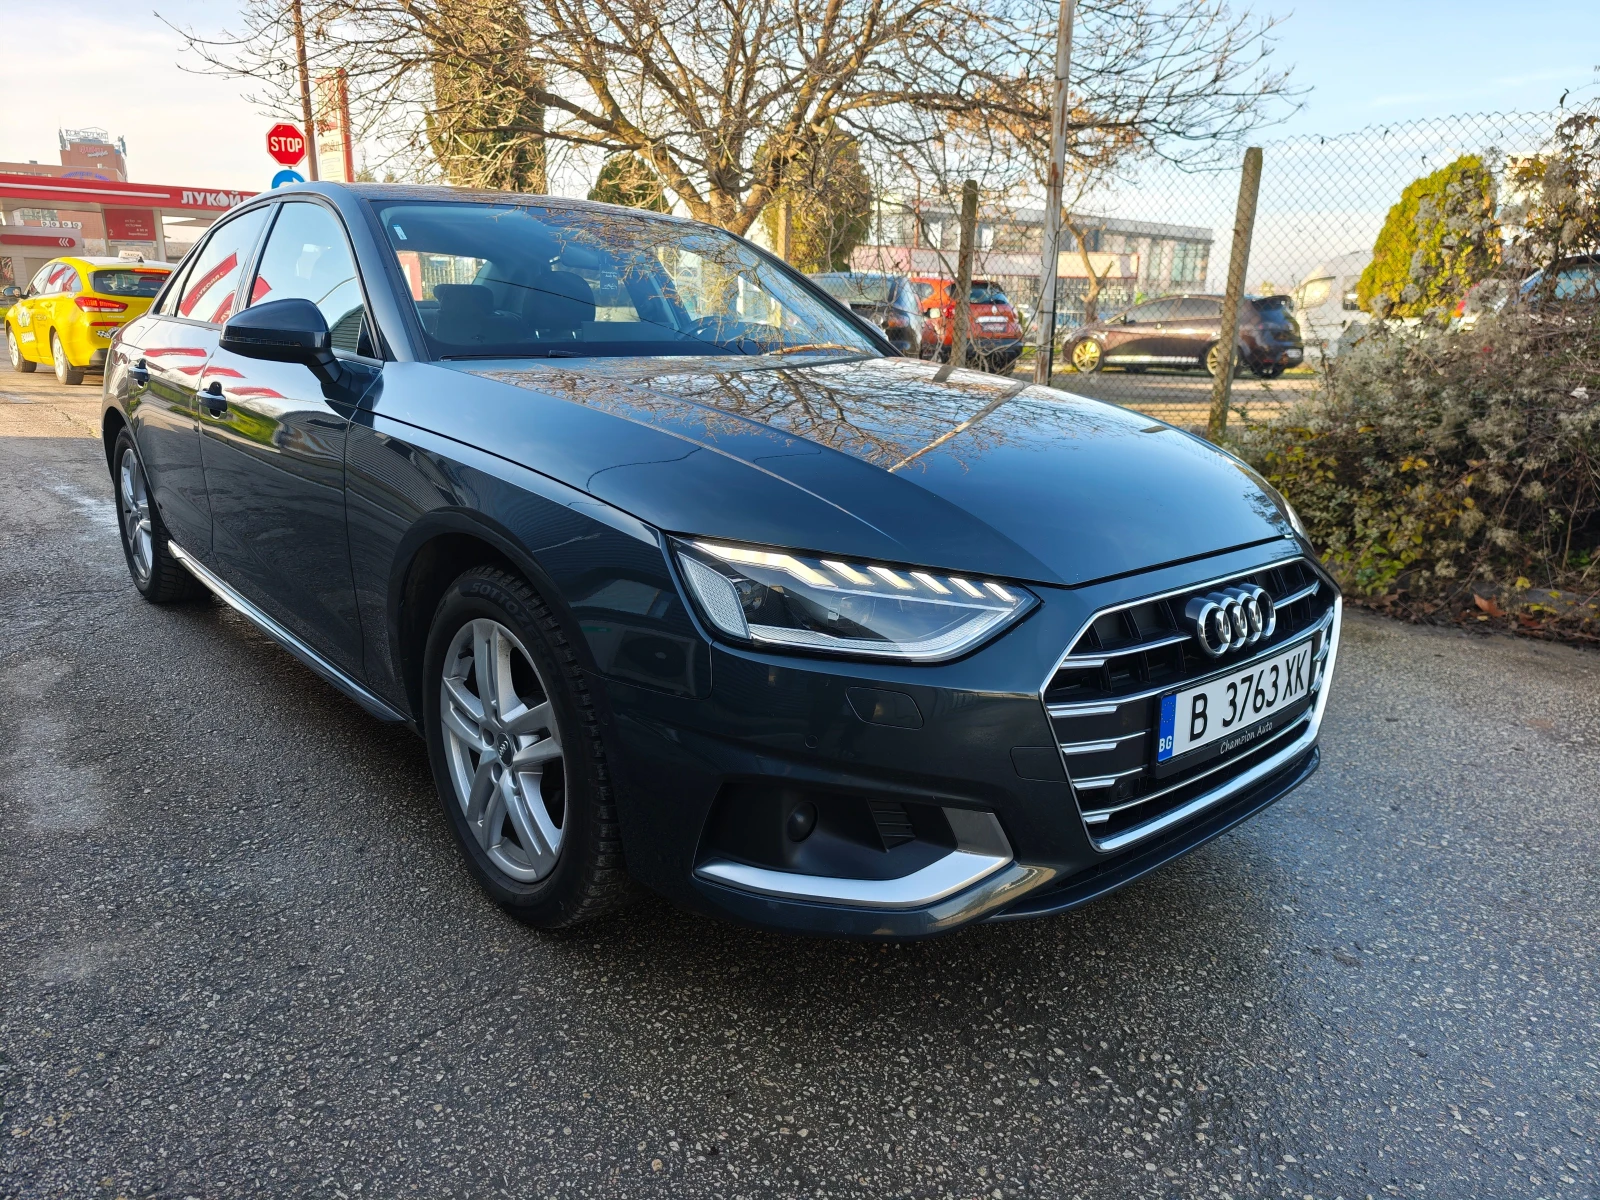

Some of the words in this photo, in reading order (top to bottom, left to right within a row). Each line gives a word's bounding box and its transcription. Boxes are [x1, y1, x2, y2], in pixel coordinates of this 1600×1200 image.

[270, 136, 303, 153] STOP
[1189, 692, 1208, 742] B
[1221, 664, 1280, 728] 3763
[1281, 649, 1308, 701] XK
[1158, 735, 1173, 753] BG
[1219, 731, 1255, 755] Champion
[1256, 721, 1273, 737] Auto
